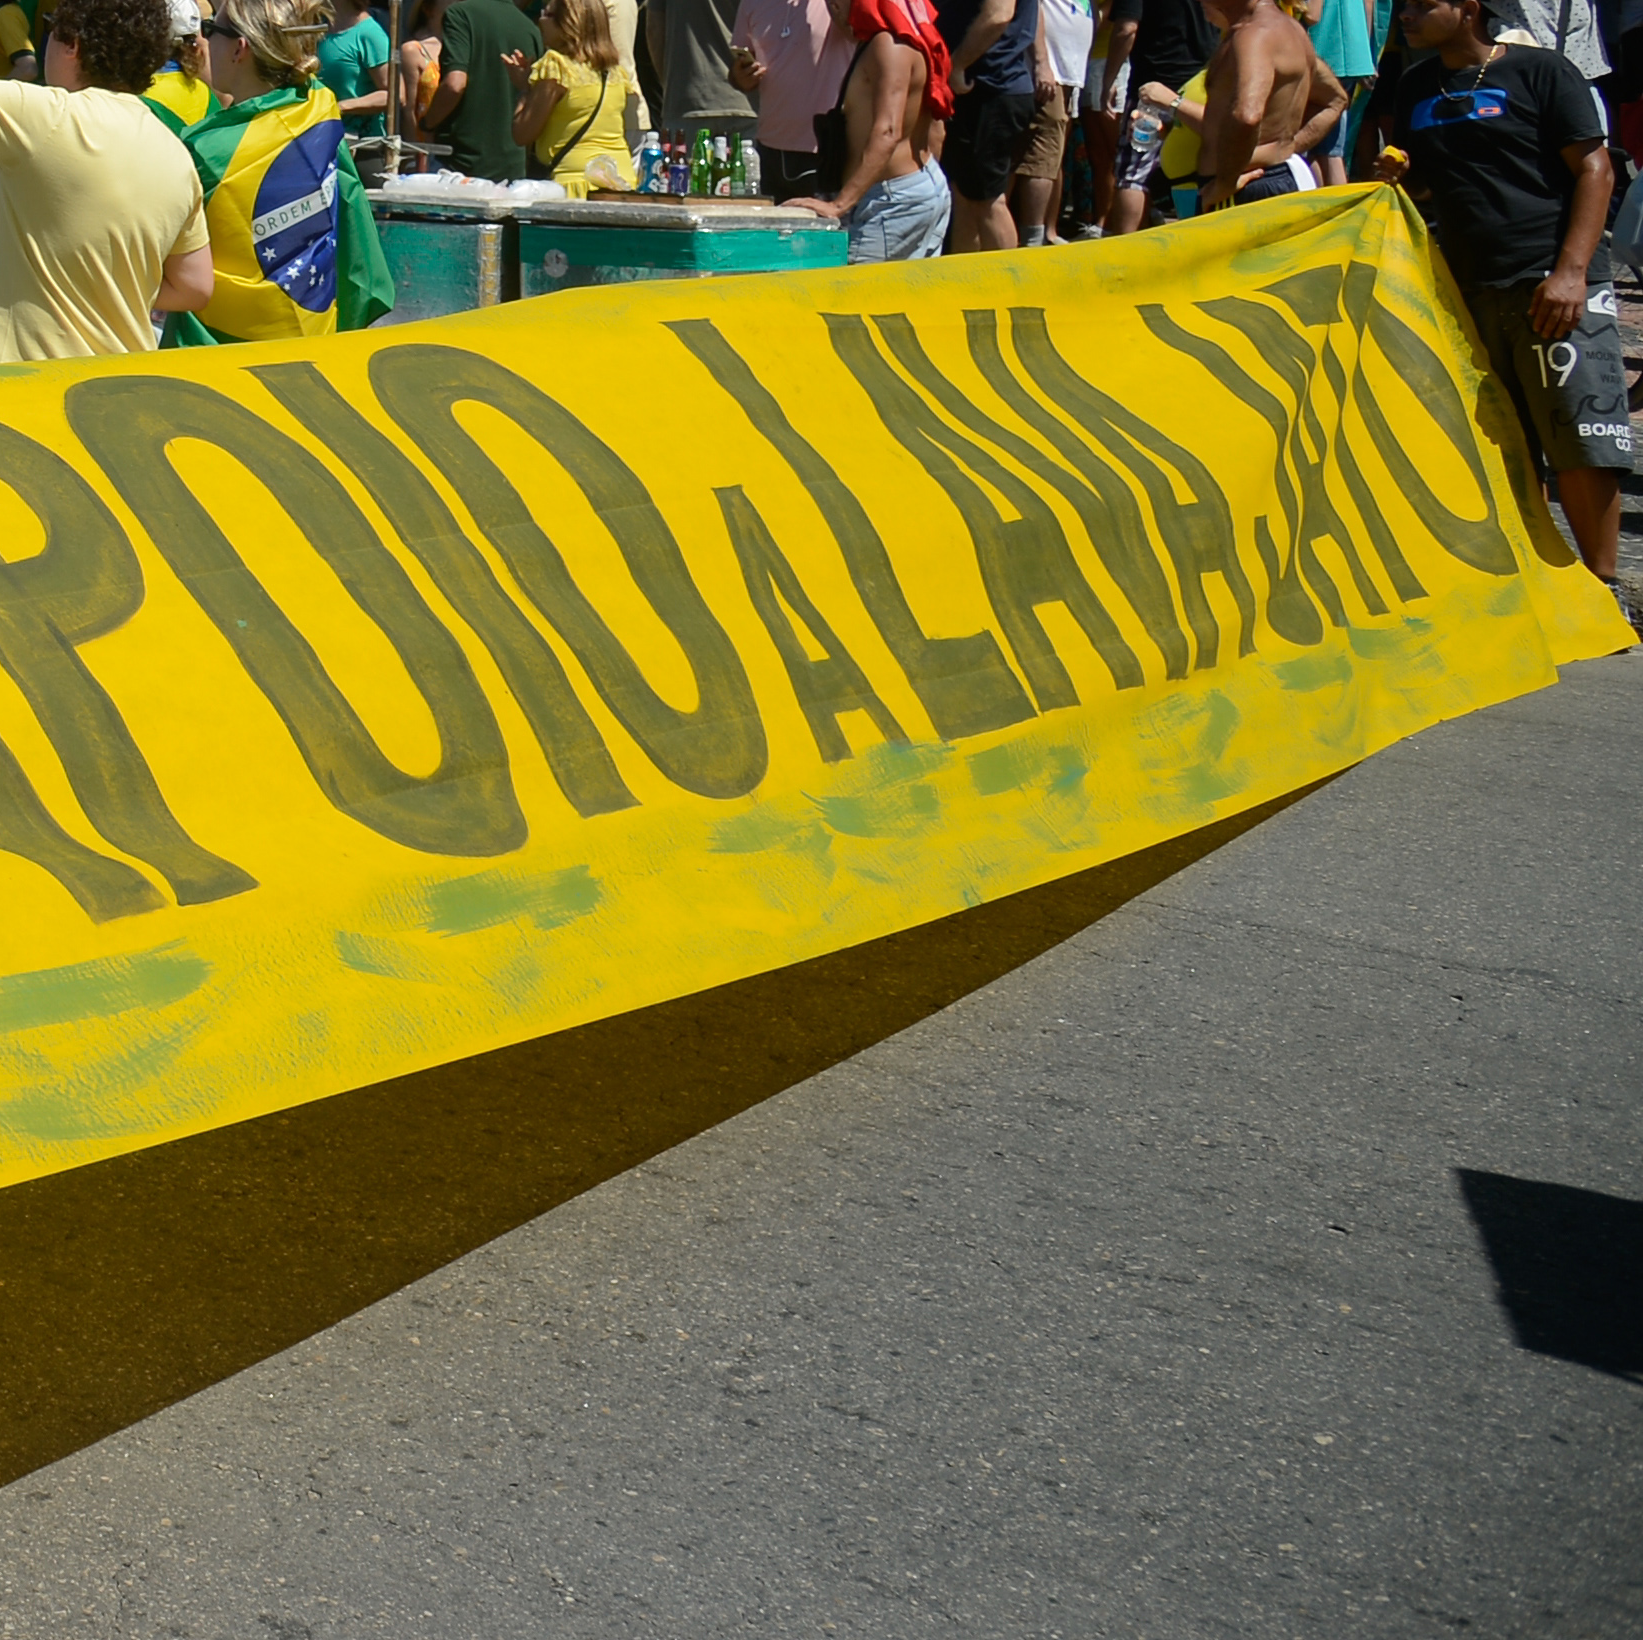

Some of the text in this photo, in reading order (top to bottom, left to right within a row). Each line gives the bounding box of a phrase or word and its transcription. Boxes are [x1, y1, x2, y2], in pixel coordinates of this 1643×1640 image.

[254, 200, 312, 236] ORDEM
[1133, 260, 1520, 647] JATO
[1531, 341, 1578, 389] 19
[659, 305, 1259, 743] LAVA
[711, 484, 910, 763] A
